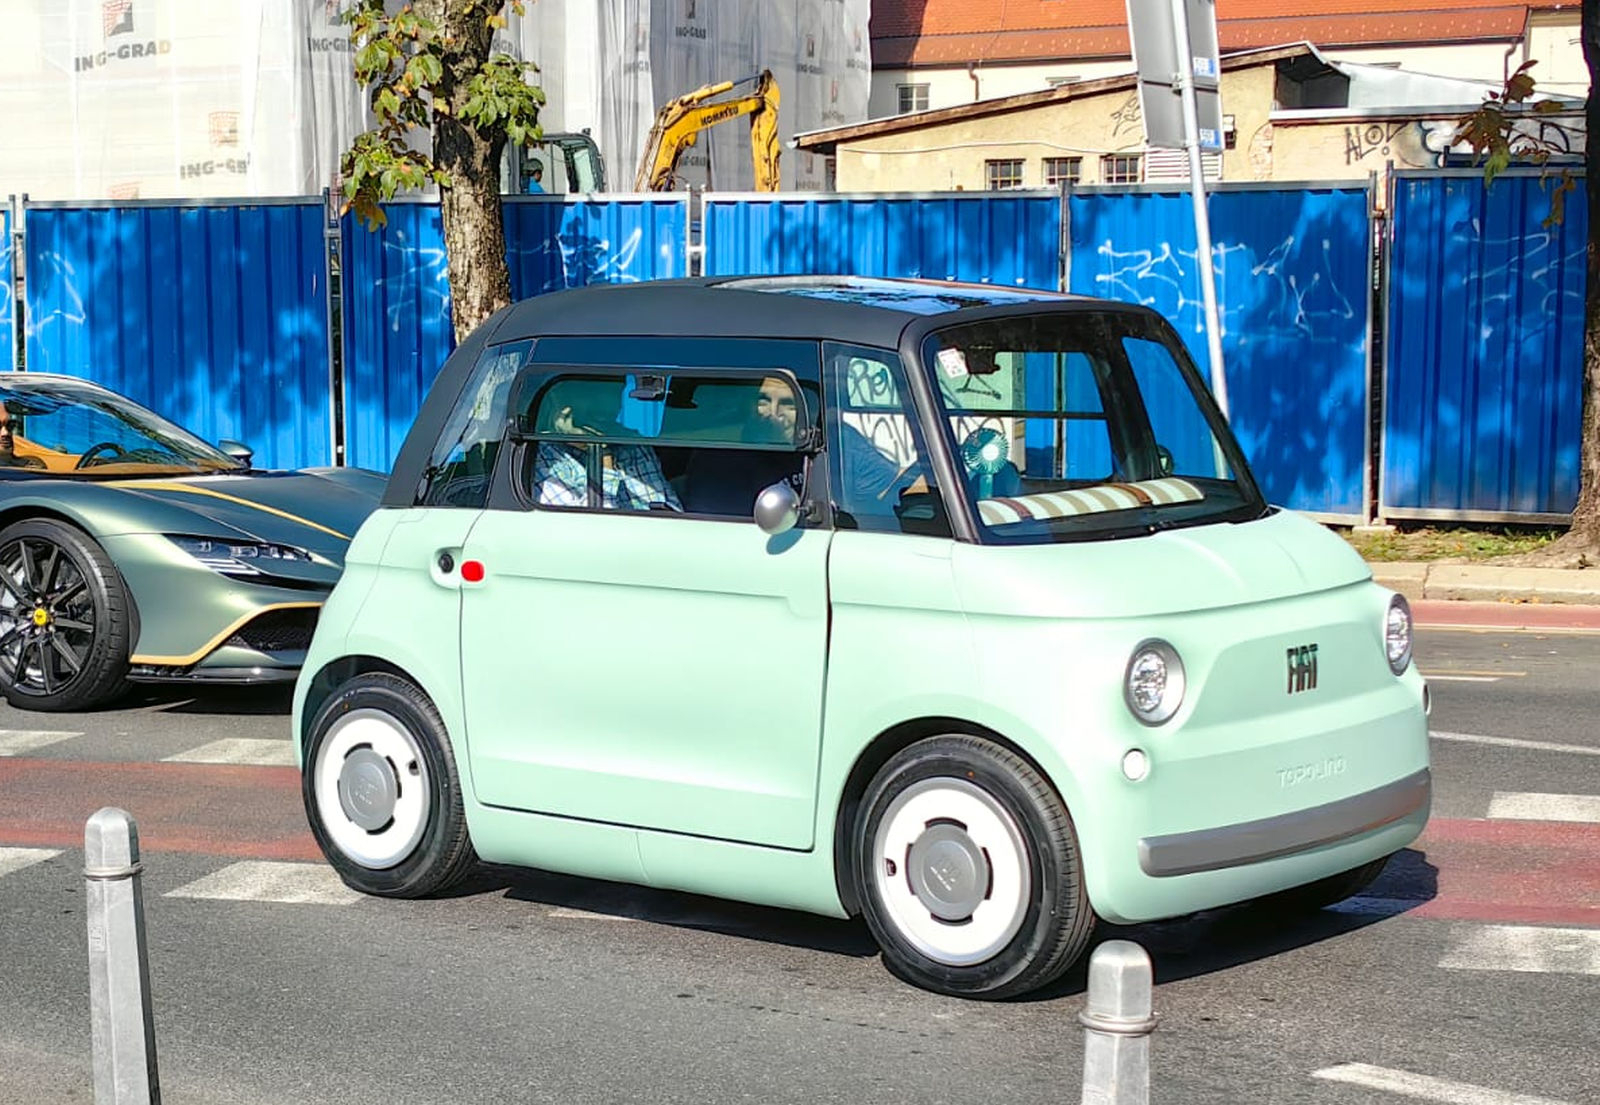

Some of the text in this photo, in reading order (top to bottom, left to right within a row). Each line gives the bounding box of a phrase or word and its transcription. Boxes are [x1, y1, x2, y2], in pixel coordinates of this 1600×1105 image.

[74, 40, 172, 73] ING-GRAD
[700, 105, 739, 126] KOMATSU
[1287, 643, 1319, 695] FIAT
